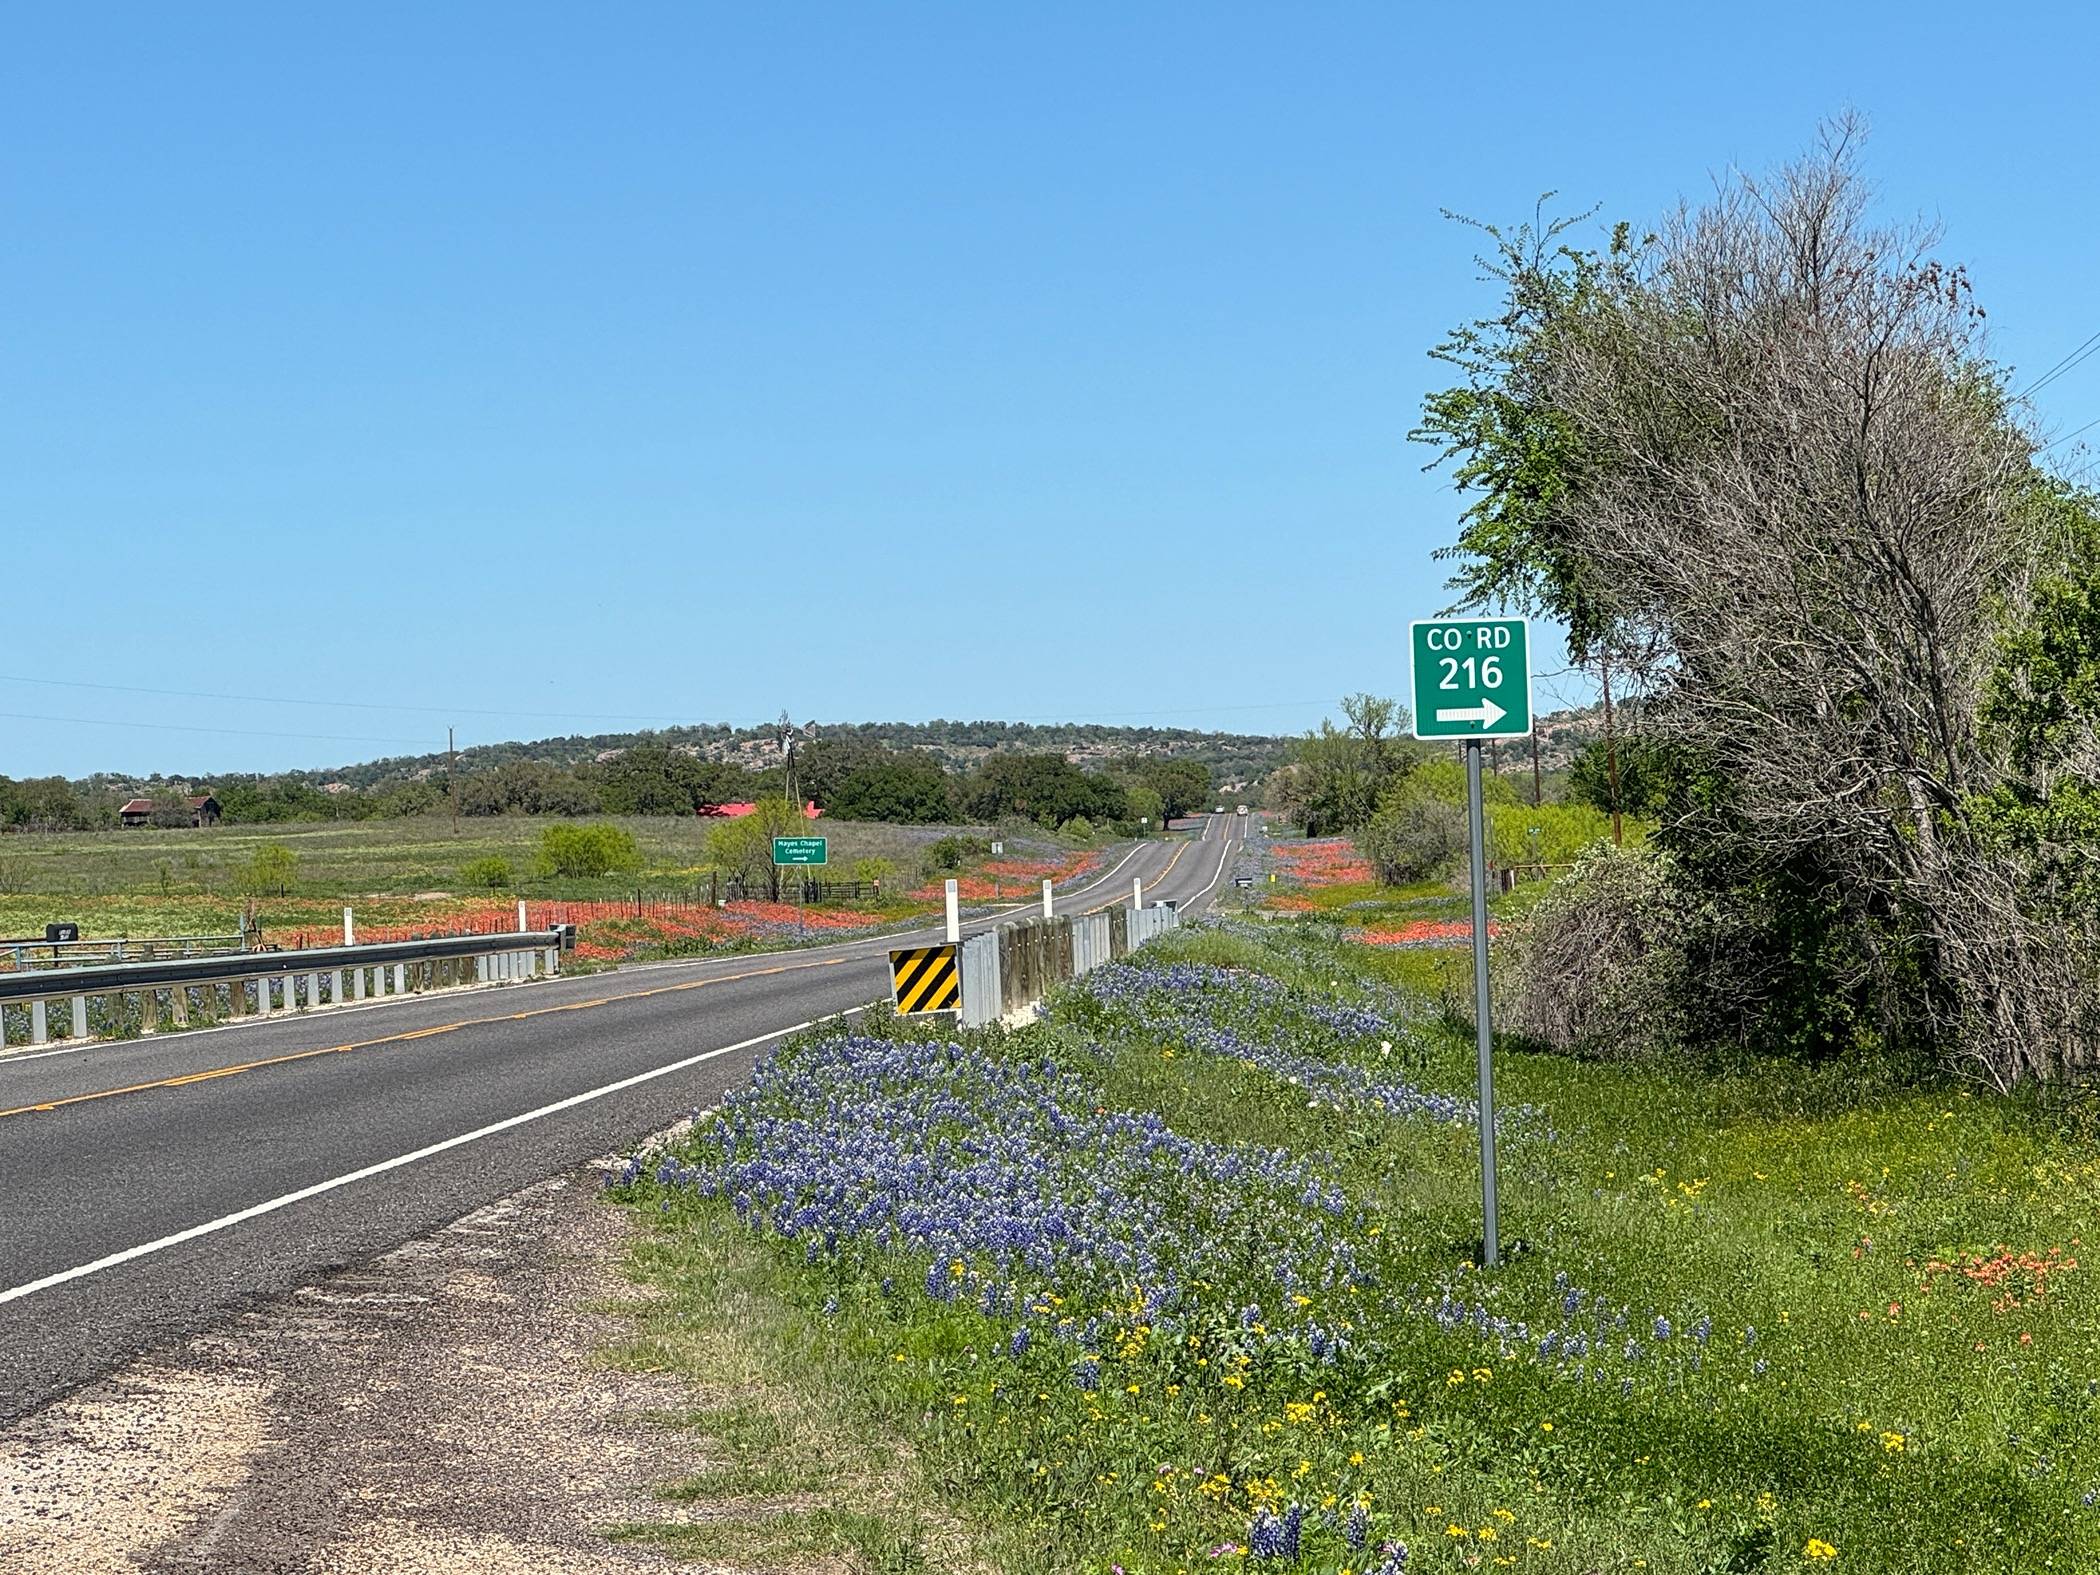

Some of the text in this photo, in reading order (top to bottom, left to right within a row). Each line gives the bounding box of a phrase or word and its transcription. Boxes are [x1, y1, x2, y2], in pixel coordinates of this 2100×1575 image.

[1427, 626, 1510, 650] CO RD
[1439, 656, 1503, 689] 216
[785, 848, 815, 856] Cemetery
